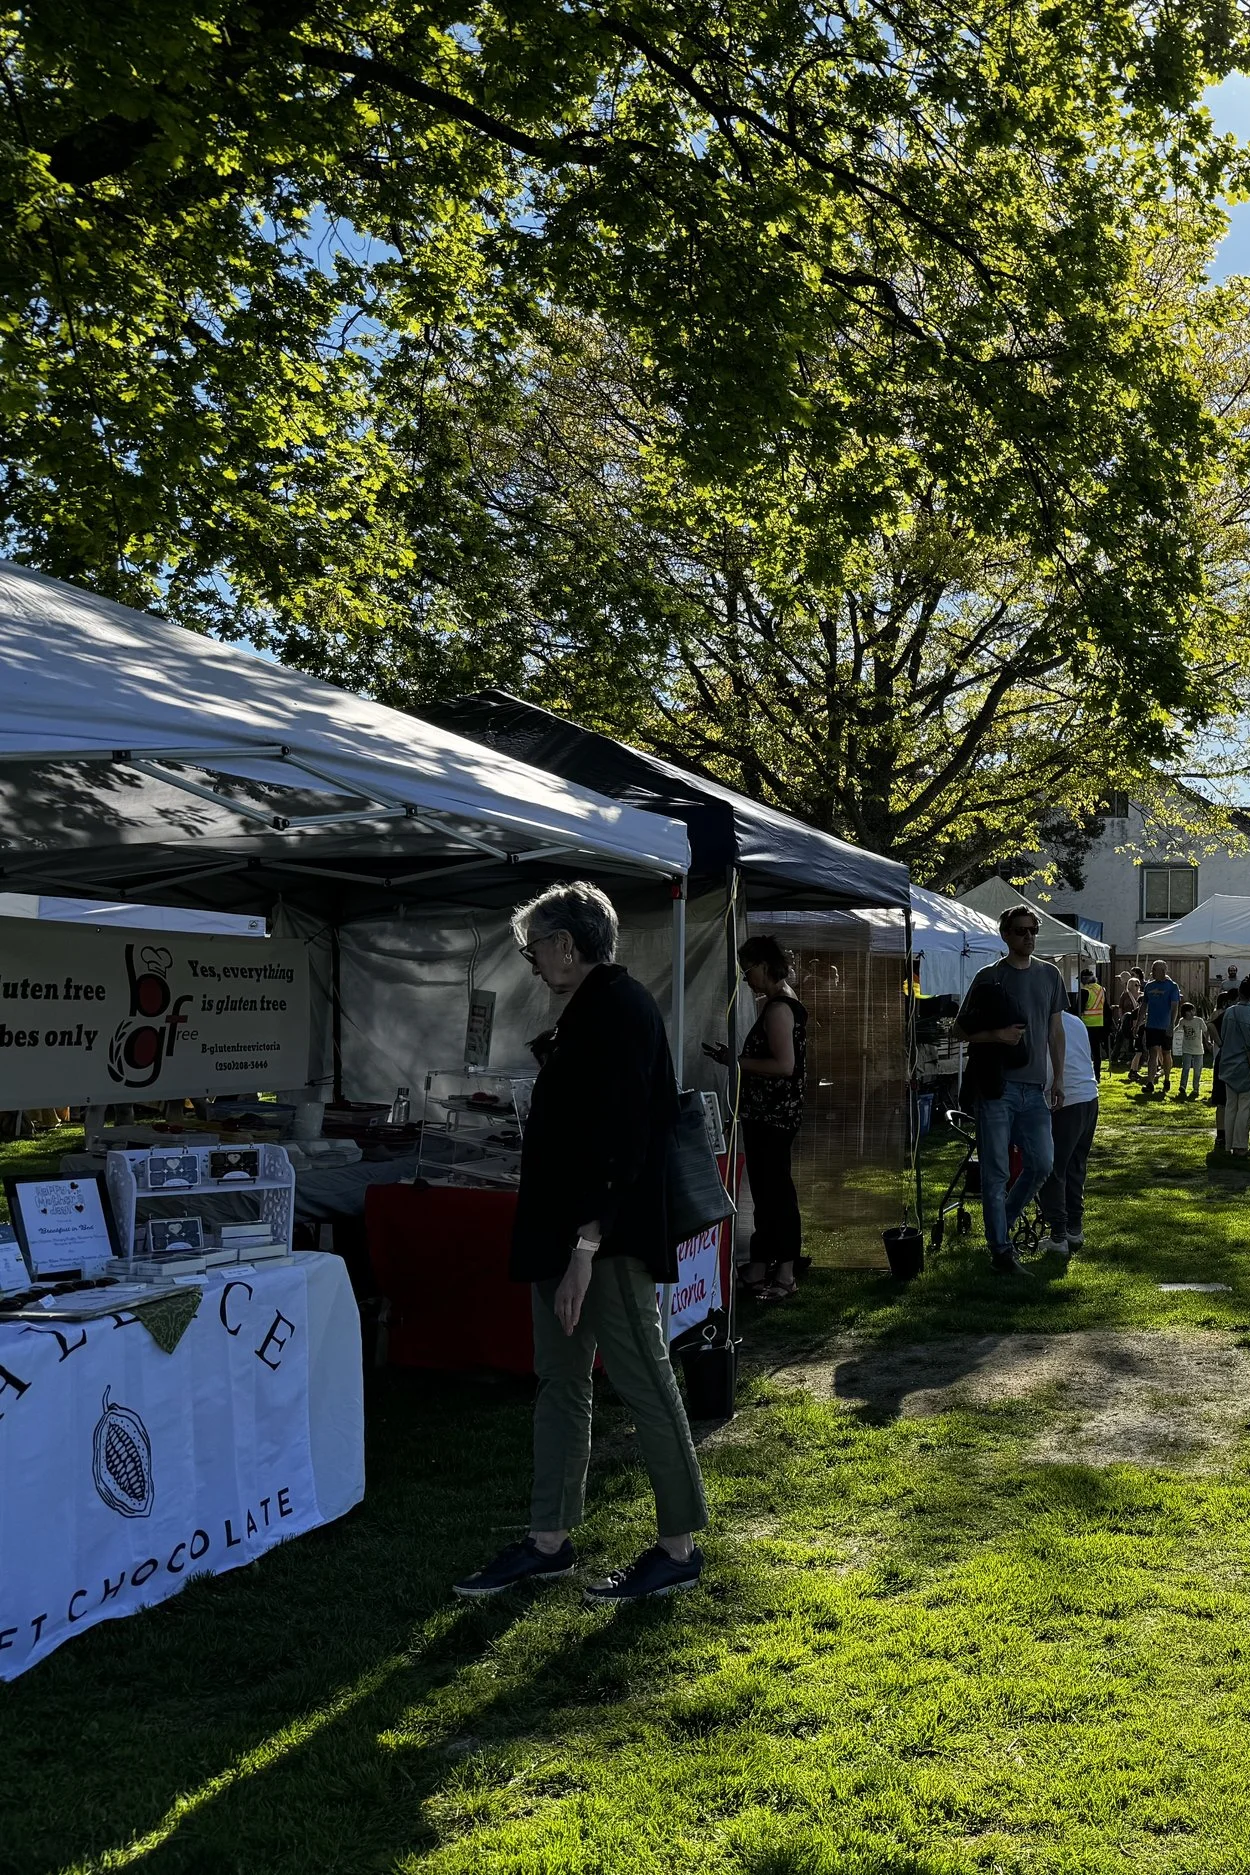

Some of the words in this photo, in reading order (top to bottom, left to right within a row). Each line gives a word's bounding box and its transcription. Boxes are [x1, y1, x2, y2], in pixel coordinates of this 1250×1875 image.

[187, 960, 222, 982] Yes,
[222, 963, 294, 983] everything
[0, 975, 59, 1001] uten
[63, 978, 106, 1001] free
[201, 994, 214, 1012] is
[216, 995, 258, 1015] gluten
[260, 995, 287, 1011] free
[45, 1024, 98, 1050] only
[68, 1487, 292, 1622] CHOCOLATE
